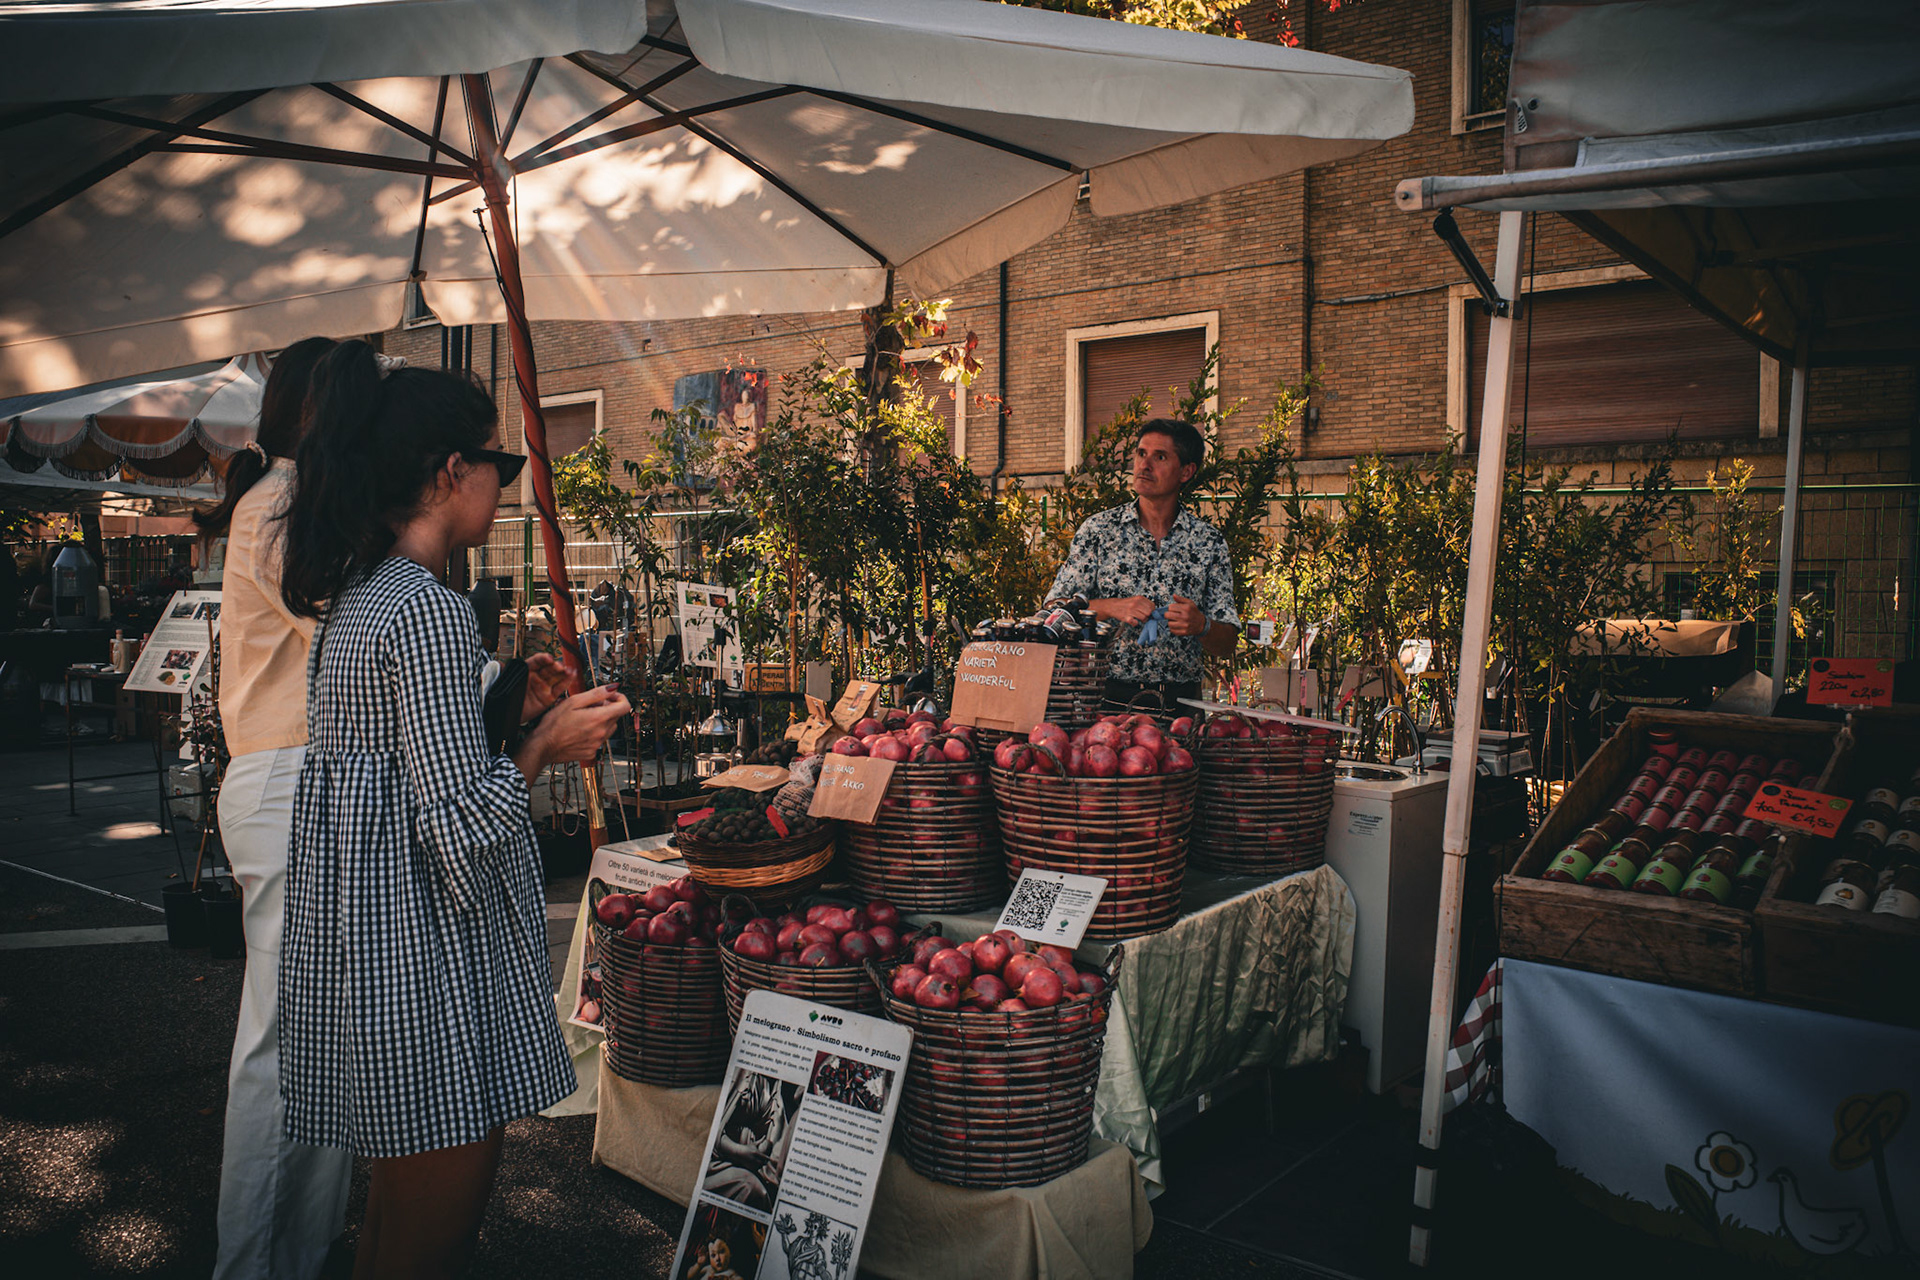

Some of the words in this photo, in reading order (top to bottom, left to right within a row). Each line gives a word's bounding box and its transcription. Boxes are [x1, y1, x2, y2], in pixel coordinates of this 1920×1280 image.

[964, 656, 998, 668] VARIETÀ
[960, 672, 1016, 690] WONDERFUL
[842, 779, 864, 790] AKKO
[608, 860, 621, 869] Oltre
[622, 863, 630, 871] 50
[630, 866, 648, 876] varietà
[650, 870, 655, 878] di
[616, 873, 627, 882] frutti
[628, 878, 646, 886] antichi
[746, 1014, 752, 1022] Il
[753, 1016, 792, 1034] melograno
[797, 1028, 840, 1046] Simbolismo
[842, 1040, 864, 1052] sacro
[870, 1048, 902, 1062] profano
